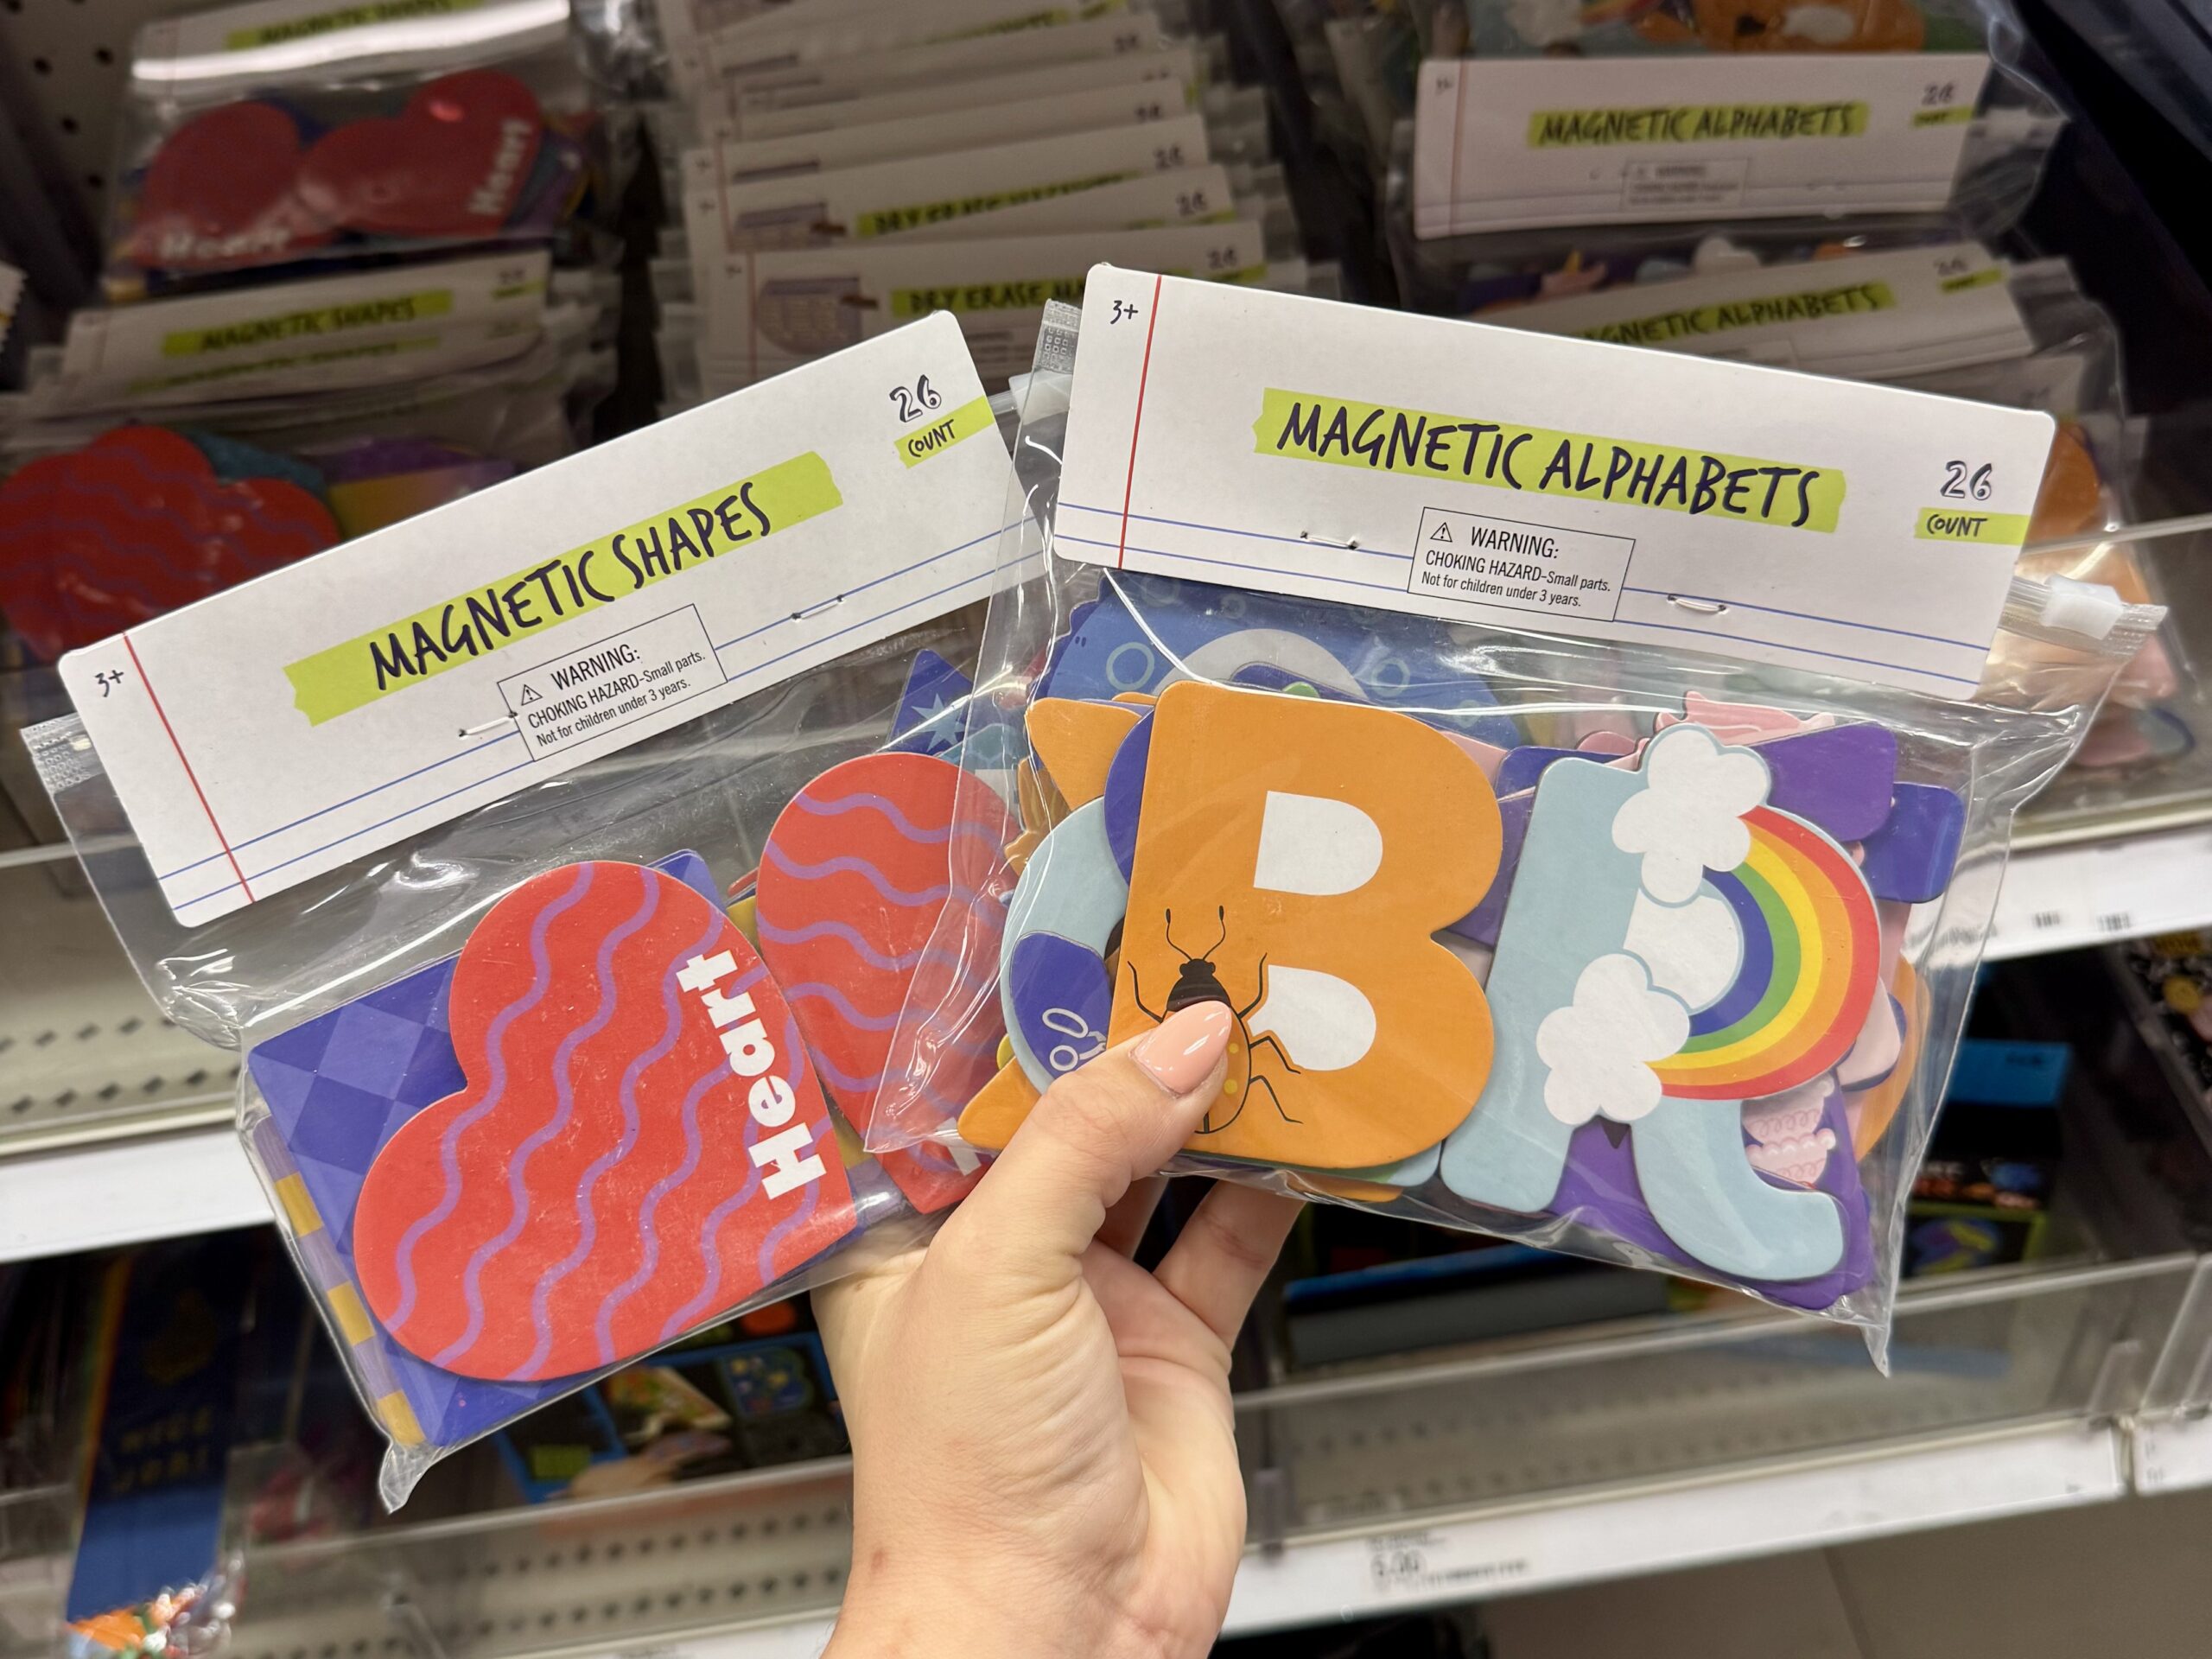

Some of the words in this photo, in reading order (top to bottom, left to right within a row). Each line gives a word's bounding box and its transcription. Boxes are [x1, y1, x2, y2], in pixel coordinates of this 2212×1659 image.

[1537, 108, 1687, 145] MAGNETIC
[1694, 103, 1854, 140] ALPHABETS
[1109, 299, 1139, 324] 3+
[1716, 283, 1880, 327] ALPHABETS
[888, 373, 943, 423] 26
[907, 419, 958, 458] COUNT
[1275, 402, 1534, 491] MAGNETIC
[1538, 437, 1820, 528] ALPHABETS
[1939, 460, 1993, 501] 26
[1470, 525, 1560, 559] WARNING:
[1925, 512, 1987, 538] COUNT
[369, 550, 616, 691] MAGNETIC
[611, 481, 772, 590] SHAPES
[1421, 570, 1441, 587] Not
[1443, 575, 1459, 589] for
[1459, 577, 1503, 596] children
[1505, 585, 1539, 601] under
[1539, 589, 1548, 603] 3
[1548, 593, 1582, 607] years.
[1425, 549, 1485, 574] CHOKING
[1579, 577, 1611, 593] parts.
[94, 668, 125, 698] 3+
[550, 643, 641, 691] WARNING:
[527, 690, 588, 729] CHOKING
[676, 650, 707, 672] parts.
[536, 729, 560, 747] Not
[557, 723, 575, 739] for
[575, 707, 618, 733] children
[618, 697, 649, 715] under
[648, 690, 658, 702] 3
[658, 680, 692, 701] years.
[675, 948, 828, 1201] Heart
